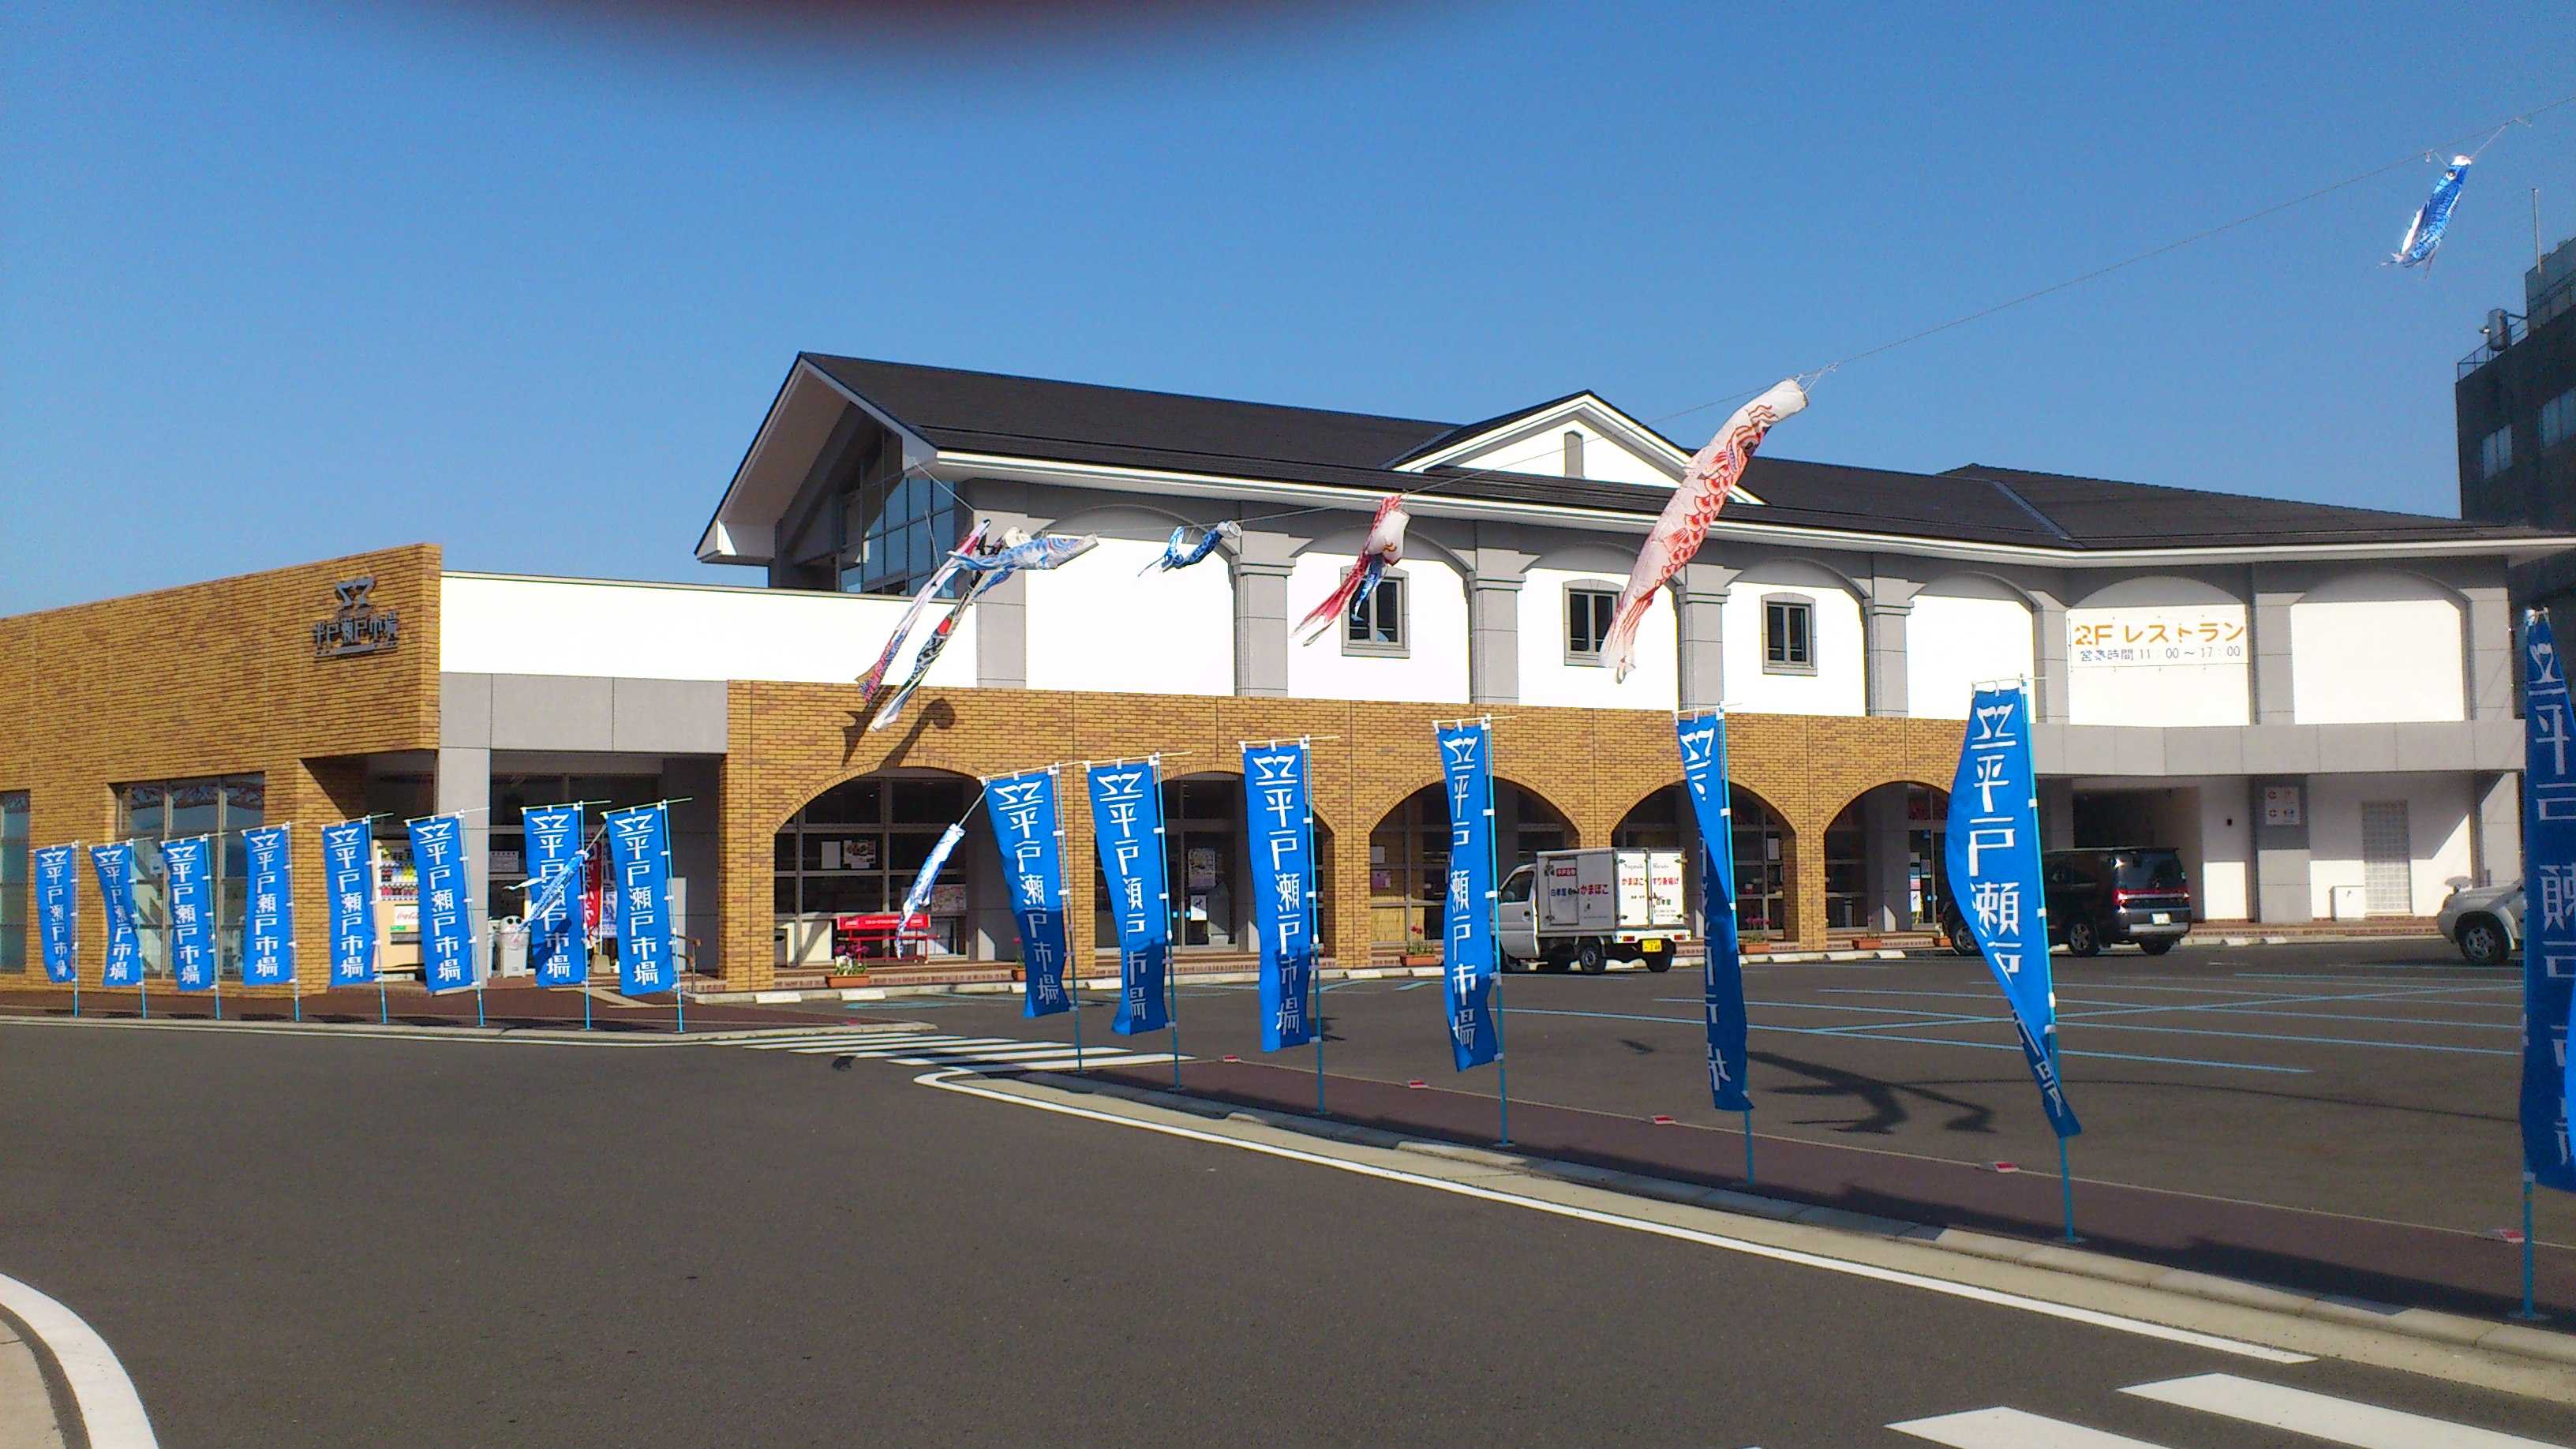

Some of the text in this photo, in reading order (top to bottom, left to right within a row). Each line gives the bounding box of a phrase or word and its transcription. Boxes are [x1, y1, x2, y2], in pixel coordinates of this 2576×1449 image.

[2074, 622, 2245, 646] 2F レストラン
[46, 866, 67, 978] 平戸瀬戸市場
[106, 865, 132, 980] 平戸瀬戸市場
[173, 862, 200, 984] 平戸瀬戸市場
[255, 850, 278, 978] 平戸瀬戸市場
[335, 848, 363, 979] 平戸瀬戸市場
[427, 843, 462, 980] 平戸瀬戸市場
[627, 835, 659, 985] 平戸瀬戸市場
[1010, 807, 1059, 1005] 平戸瀬戸市場
[1264, 788, 1301, 1036] 平戸瀬戸市場
[1450, 775, 1477, 1050] 平戸瀬戸市場
